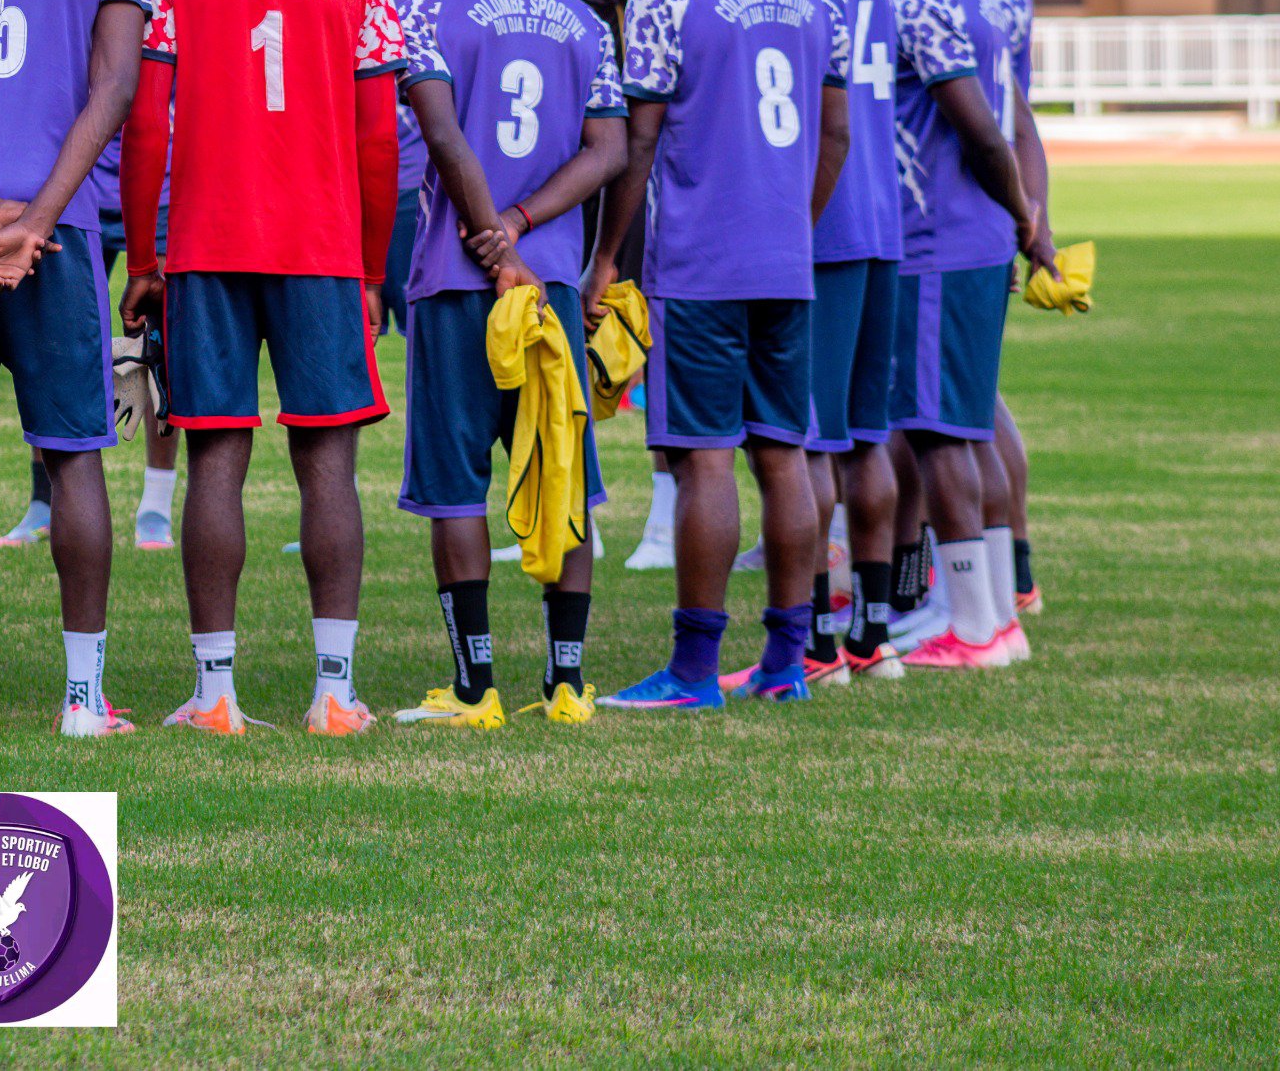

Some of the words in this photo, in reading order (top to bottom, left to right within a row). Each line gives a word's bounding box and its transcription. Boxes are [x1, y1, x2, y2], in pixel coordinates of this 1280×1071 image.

[251, 10, 285, 112] 1
[493, 18, 508, 36] DU
[526, 17, 540, 35] ET
[540, 21, 570, 44] LOBO
[764, 5, 775, 22] ET
[852, 0, 894, 100] 4
[497, 59, 543, 158] 3
[755, 47, 801, 148] 8
[559, 644, 579, 663] FS
